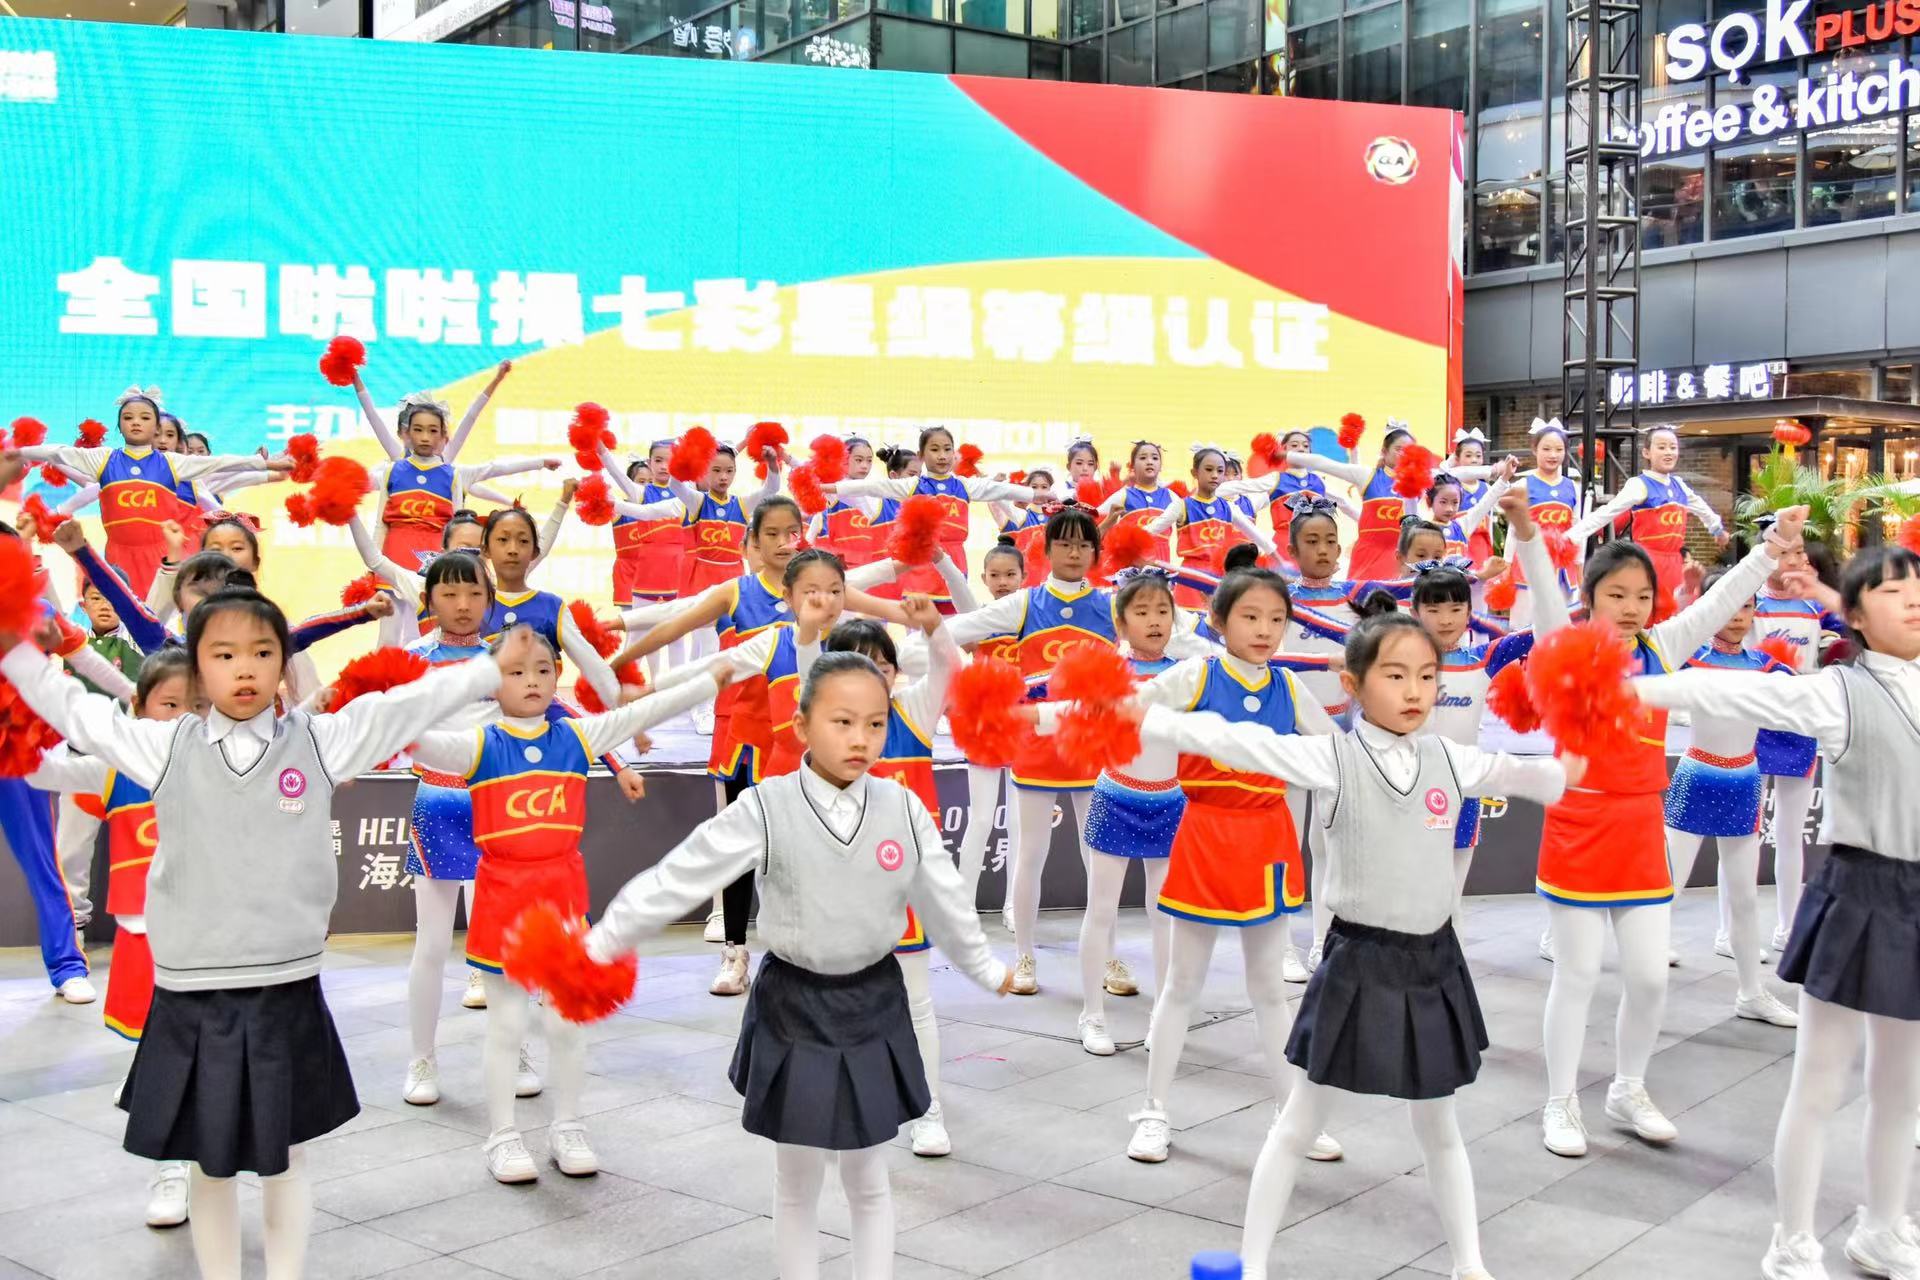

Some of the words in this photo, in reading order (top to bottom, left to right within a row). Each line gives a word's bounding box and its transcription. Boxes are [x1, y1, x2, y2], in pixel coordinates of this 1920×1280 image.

[1815, 0, 1920, 52] PLUS
[1749, 85, 1788, 135] &
[1676, 372, 1699, 400] &
[117, 489, 158, 508] CCA
[399, 498, 437, 518] CCA
[1538, 508, 1569, 525] CCA
[1660, 511, 1683, 526] CCA
[701, 526, 732, 545] CCA
[1200, 525, 1226, 542] CCA
[506, 783, 567, 819] CCA
[358, 817, 411, 846] HEL
